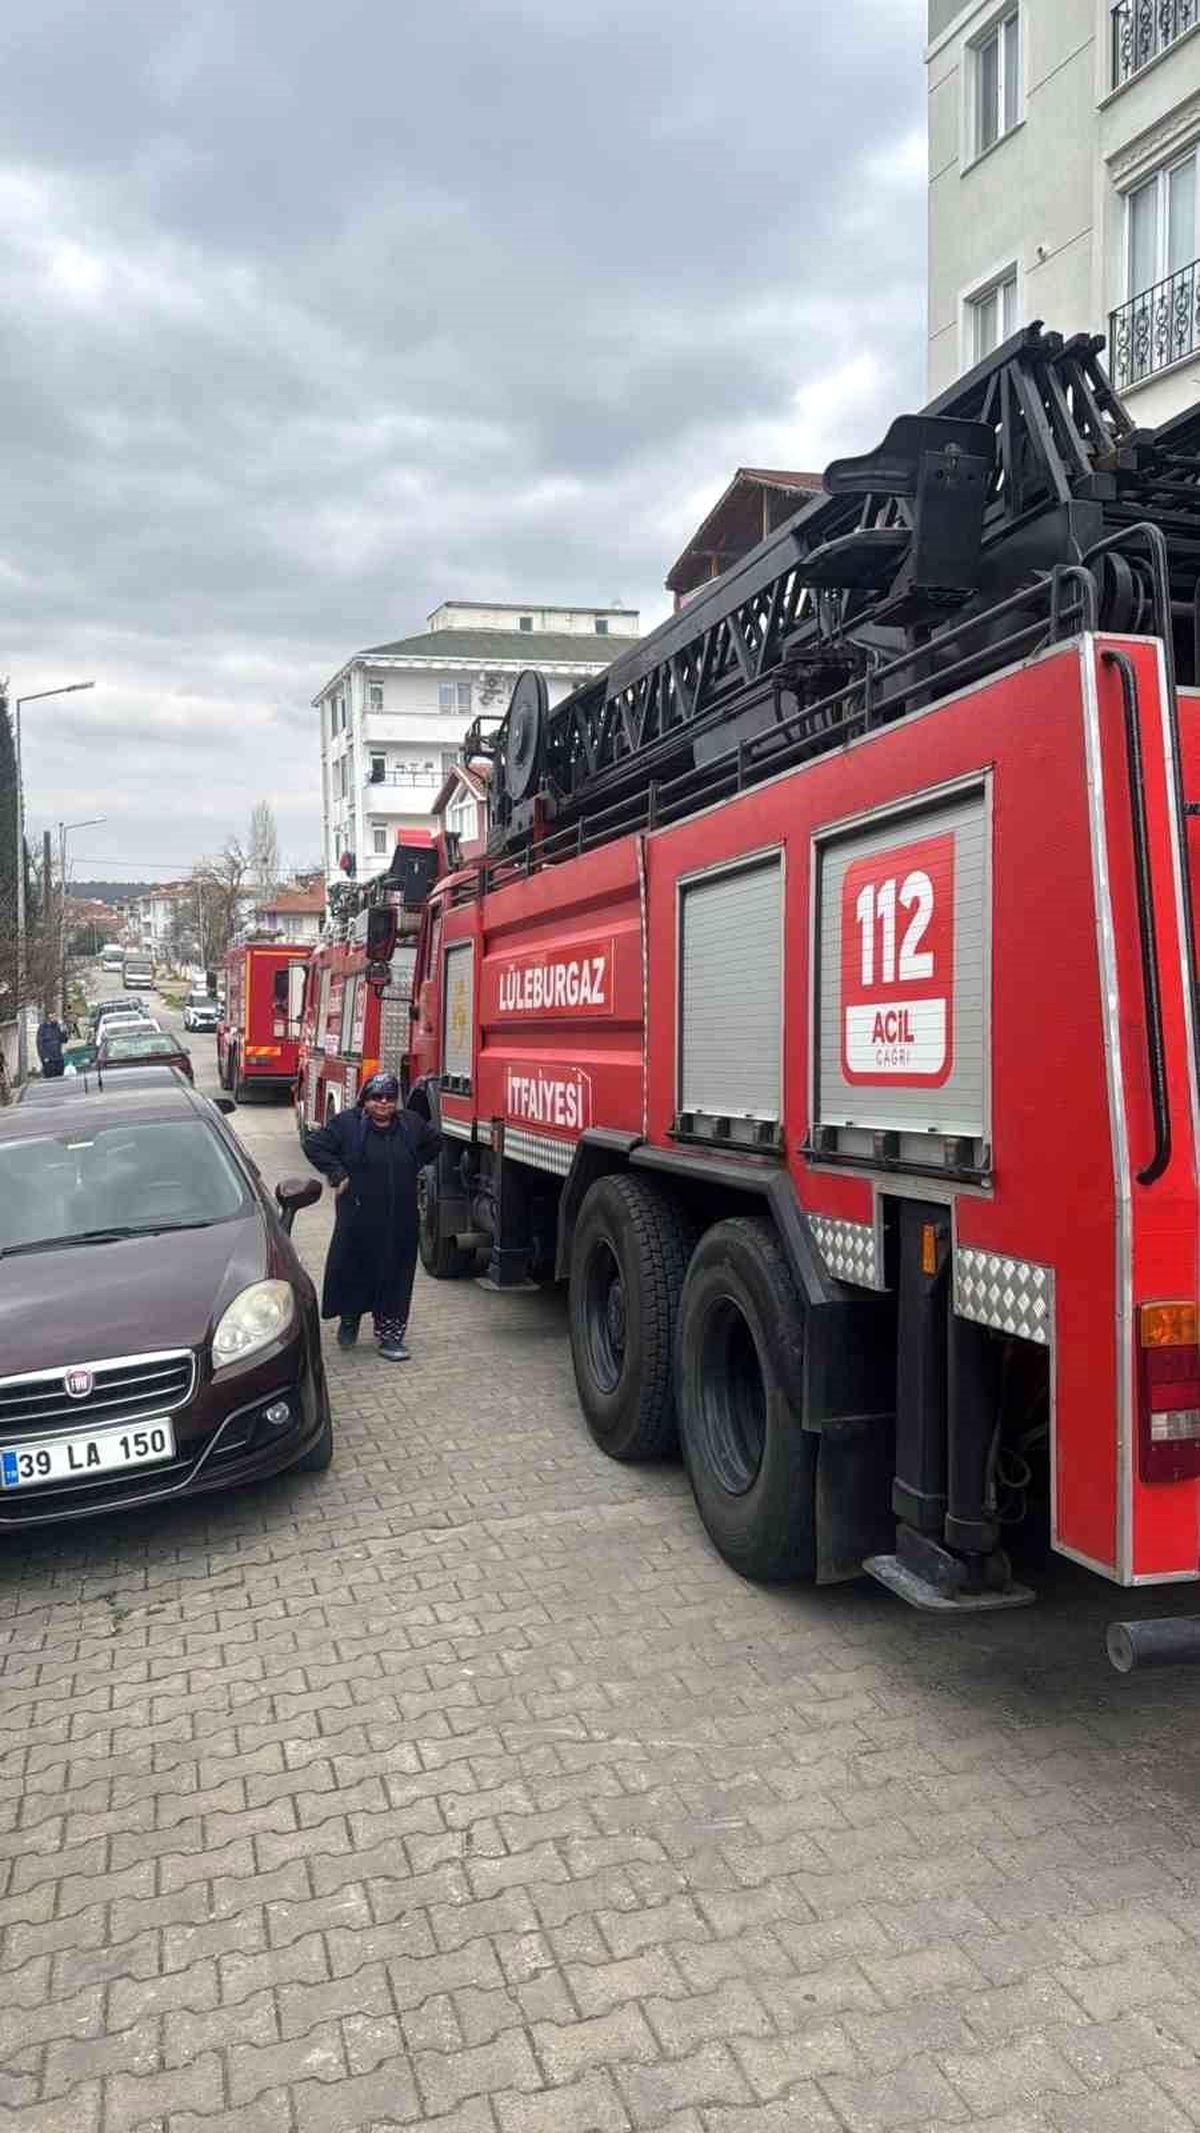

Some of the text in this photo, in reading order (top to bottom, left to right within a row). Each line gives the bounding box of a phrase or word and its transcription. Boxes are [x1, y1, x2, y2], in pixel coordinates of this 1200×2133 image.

[856, 869, 935, 987] 112
[499, 957, 605, 1011] LÜLEBURGAZ
[508, 1065, 583, 1128] İTFAİYESİ
[19, 1429, 166, 1478] 39 LA 150
